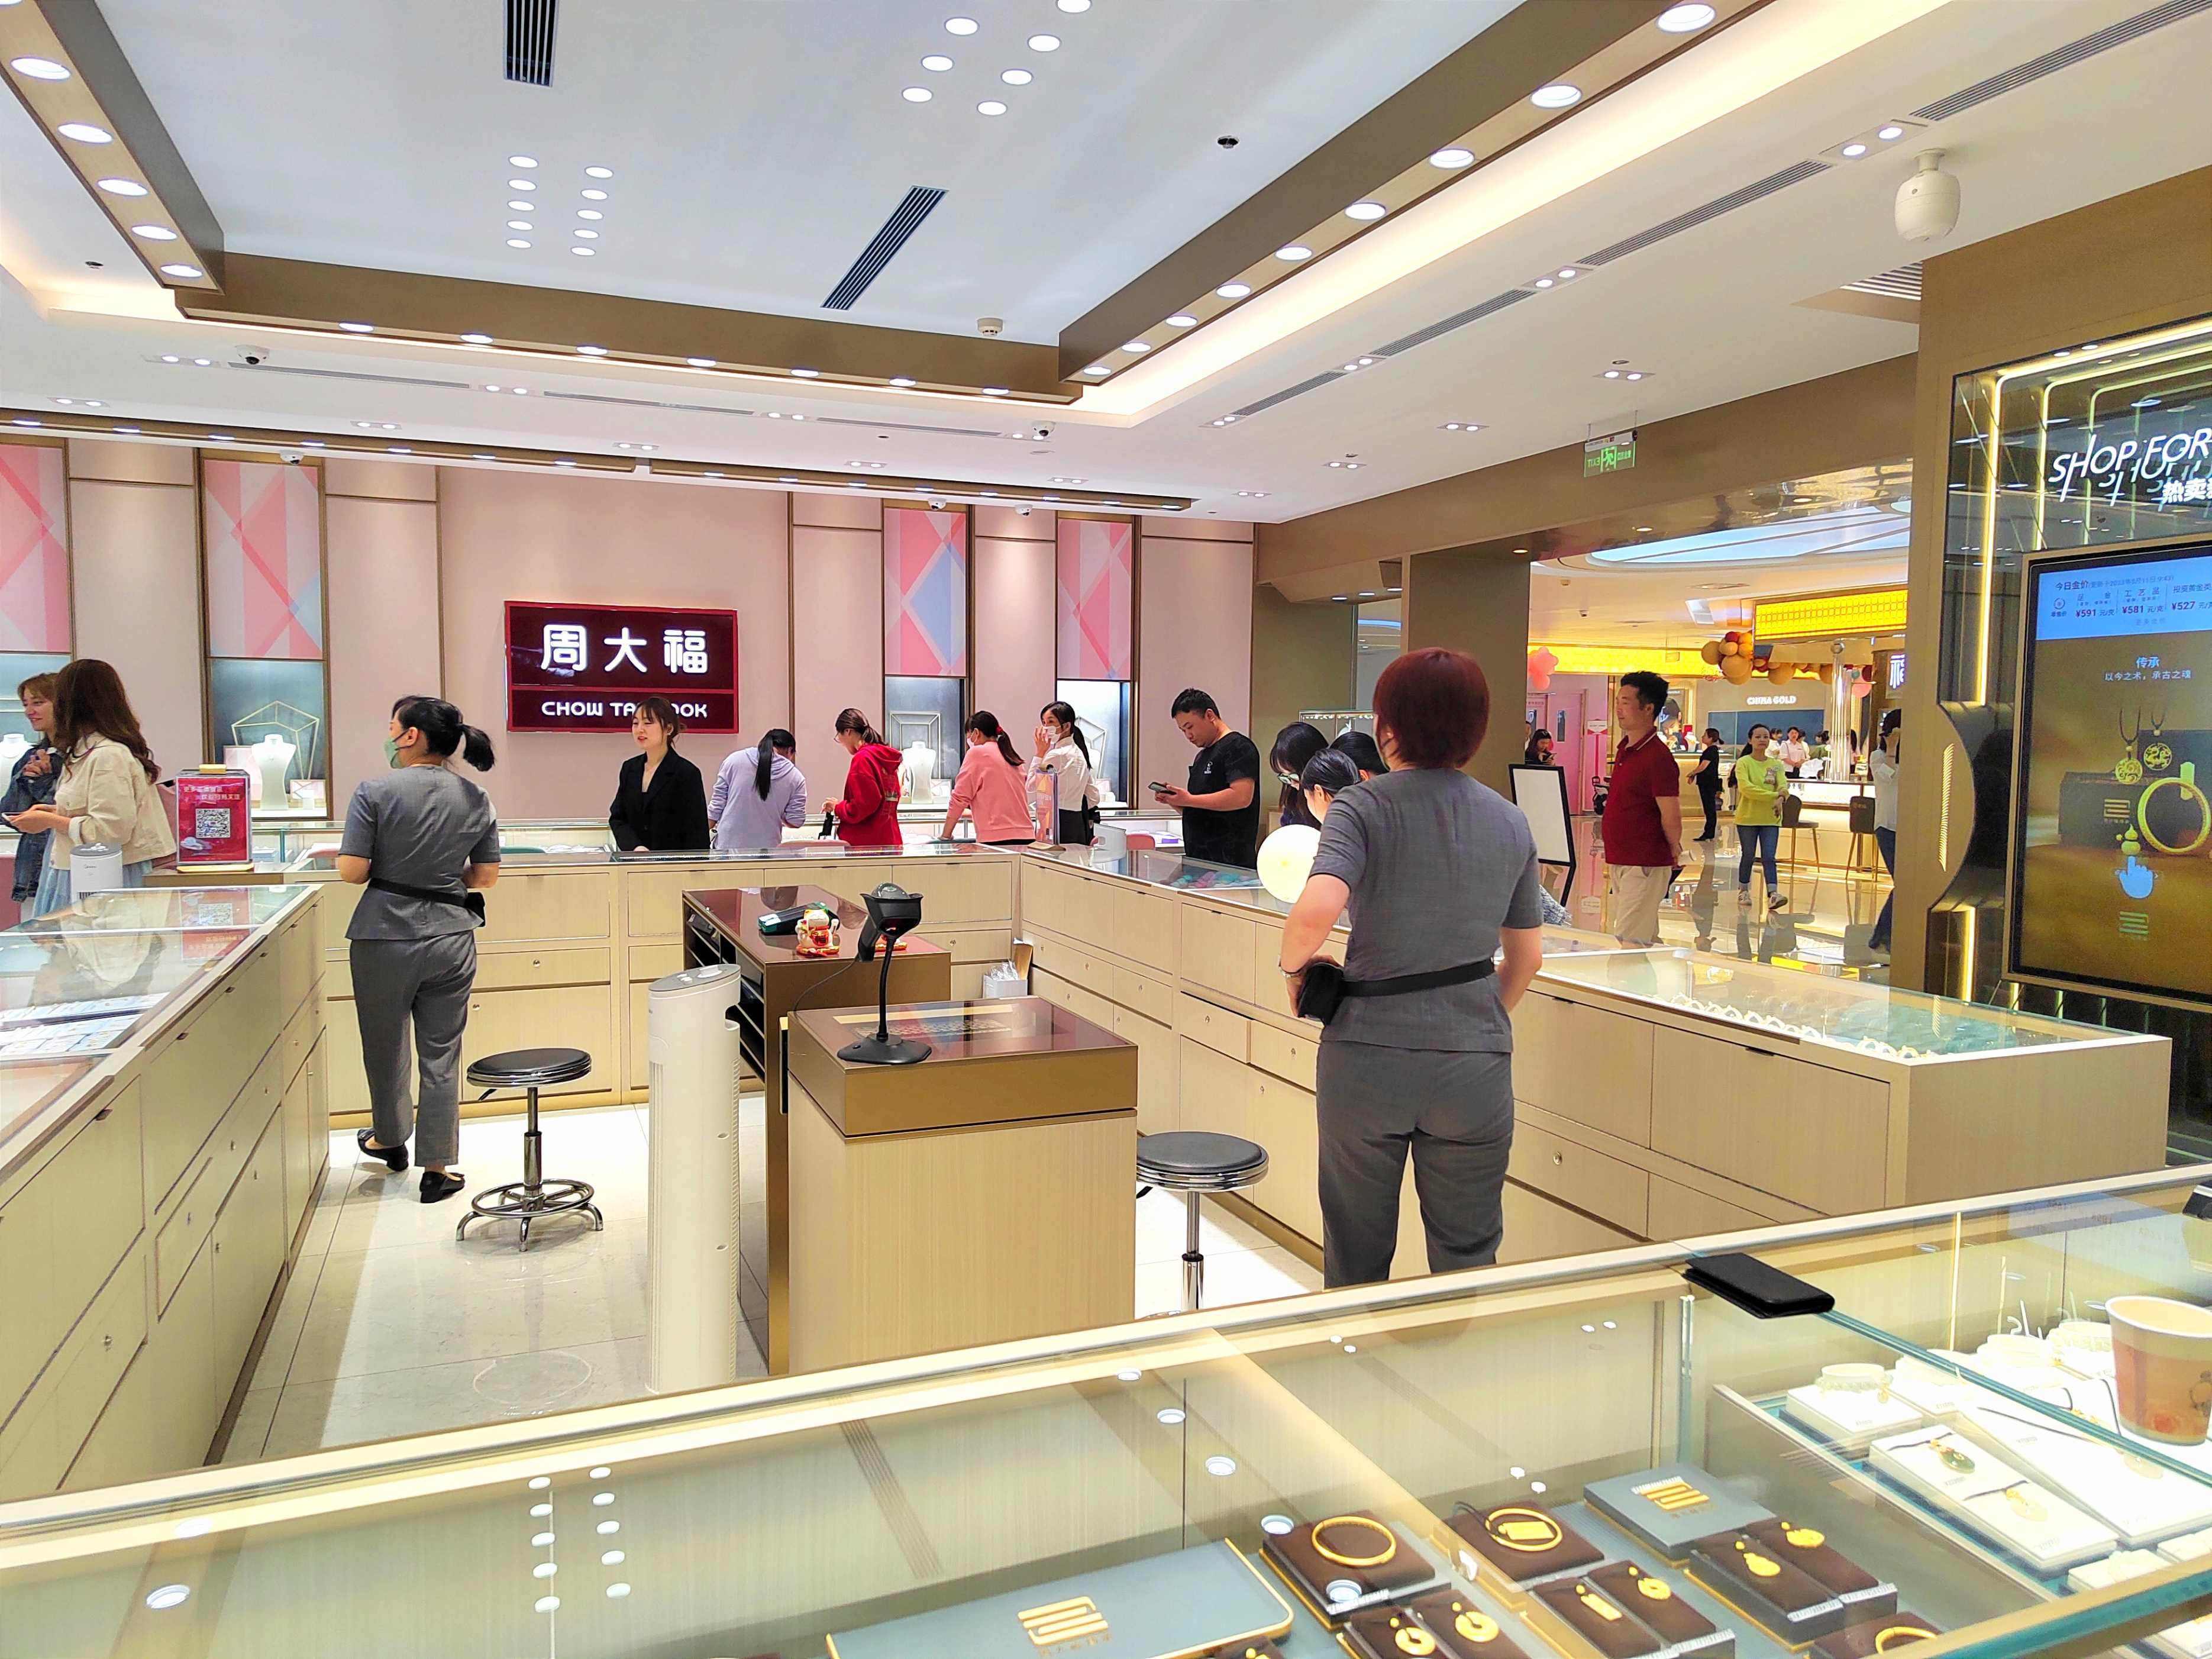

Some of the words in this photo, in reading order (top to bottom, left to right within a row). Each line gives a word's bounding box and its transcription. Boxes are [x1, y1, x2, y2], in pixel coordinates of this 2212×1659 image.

[2048, 434, 2137, 502] SHOP
[2162, 477, 2212, 504] 热卖
[2055, 580, 2088, 591] 今日金价
[2124, 588, 2160, 598] 工艺品
[2122, 605, 2145, 614] ¥581
[2172, 601, 2195, 611] ¥527
[2075, 609, 2097, 618] ¥591
[541, 624, 709, 674] 周大福
[2136, 657, 2160, 669] 传承
[1747, 696, 1772, 705] CHINA
[1772, 696, 1797, 704] GOLD
[541, 702, 603, 716] CHOW
[609, 702, 637, 716] TA
